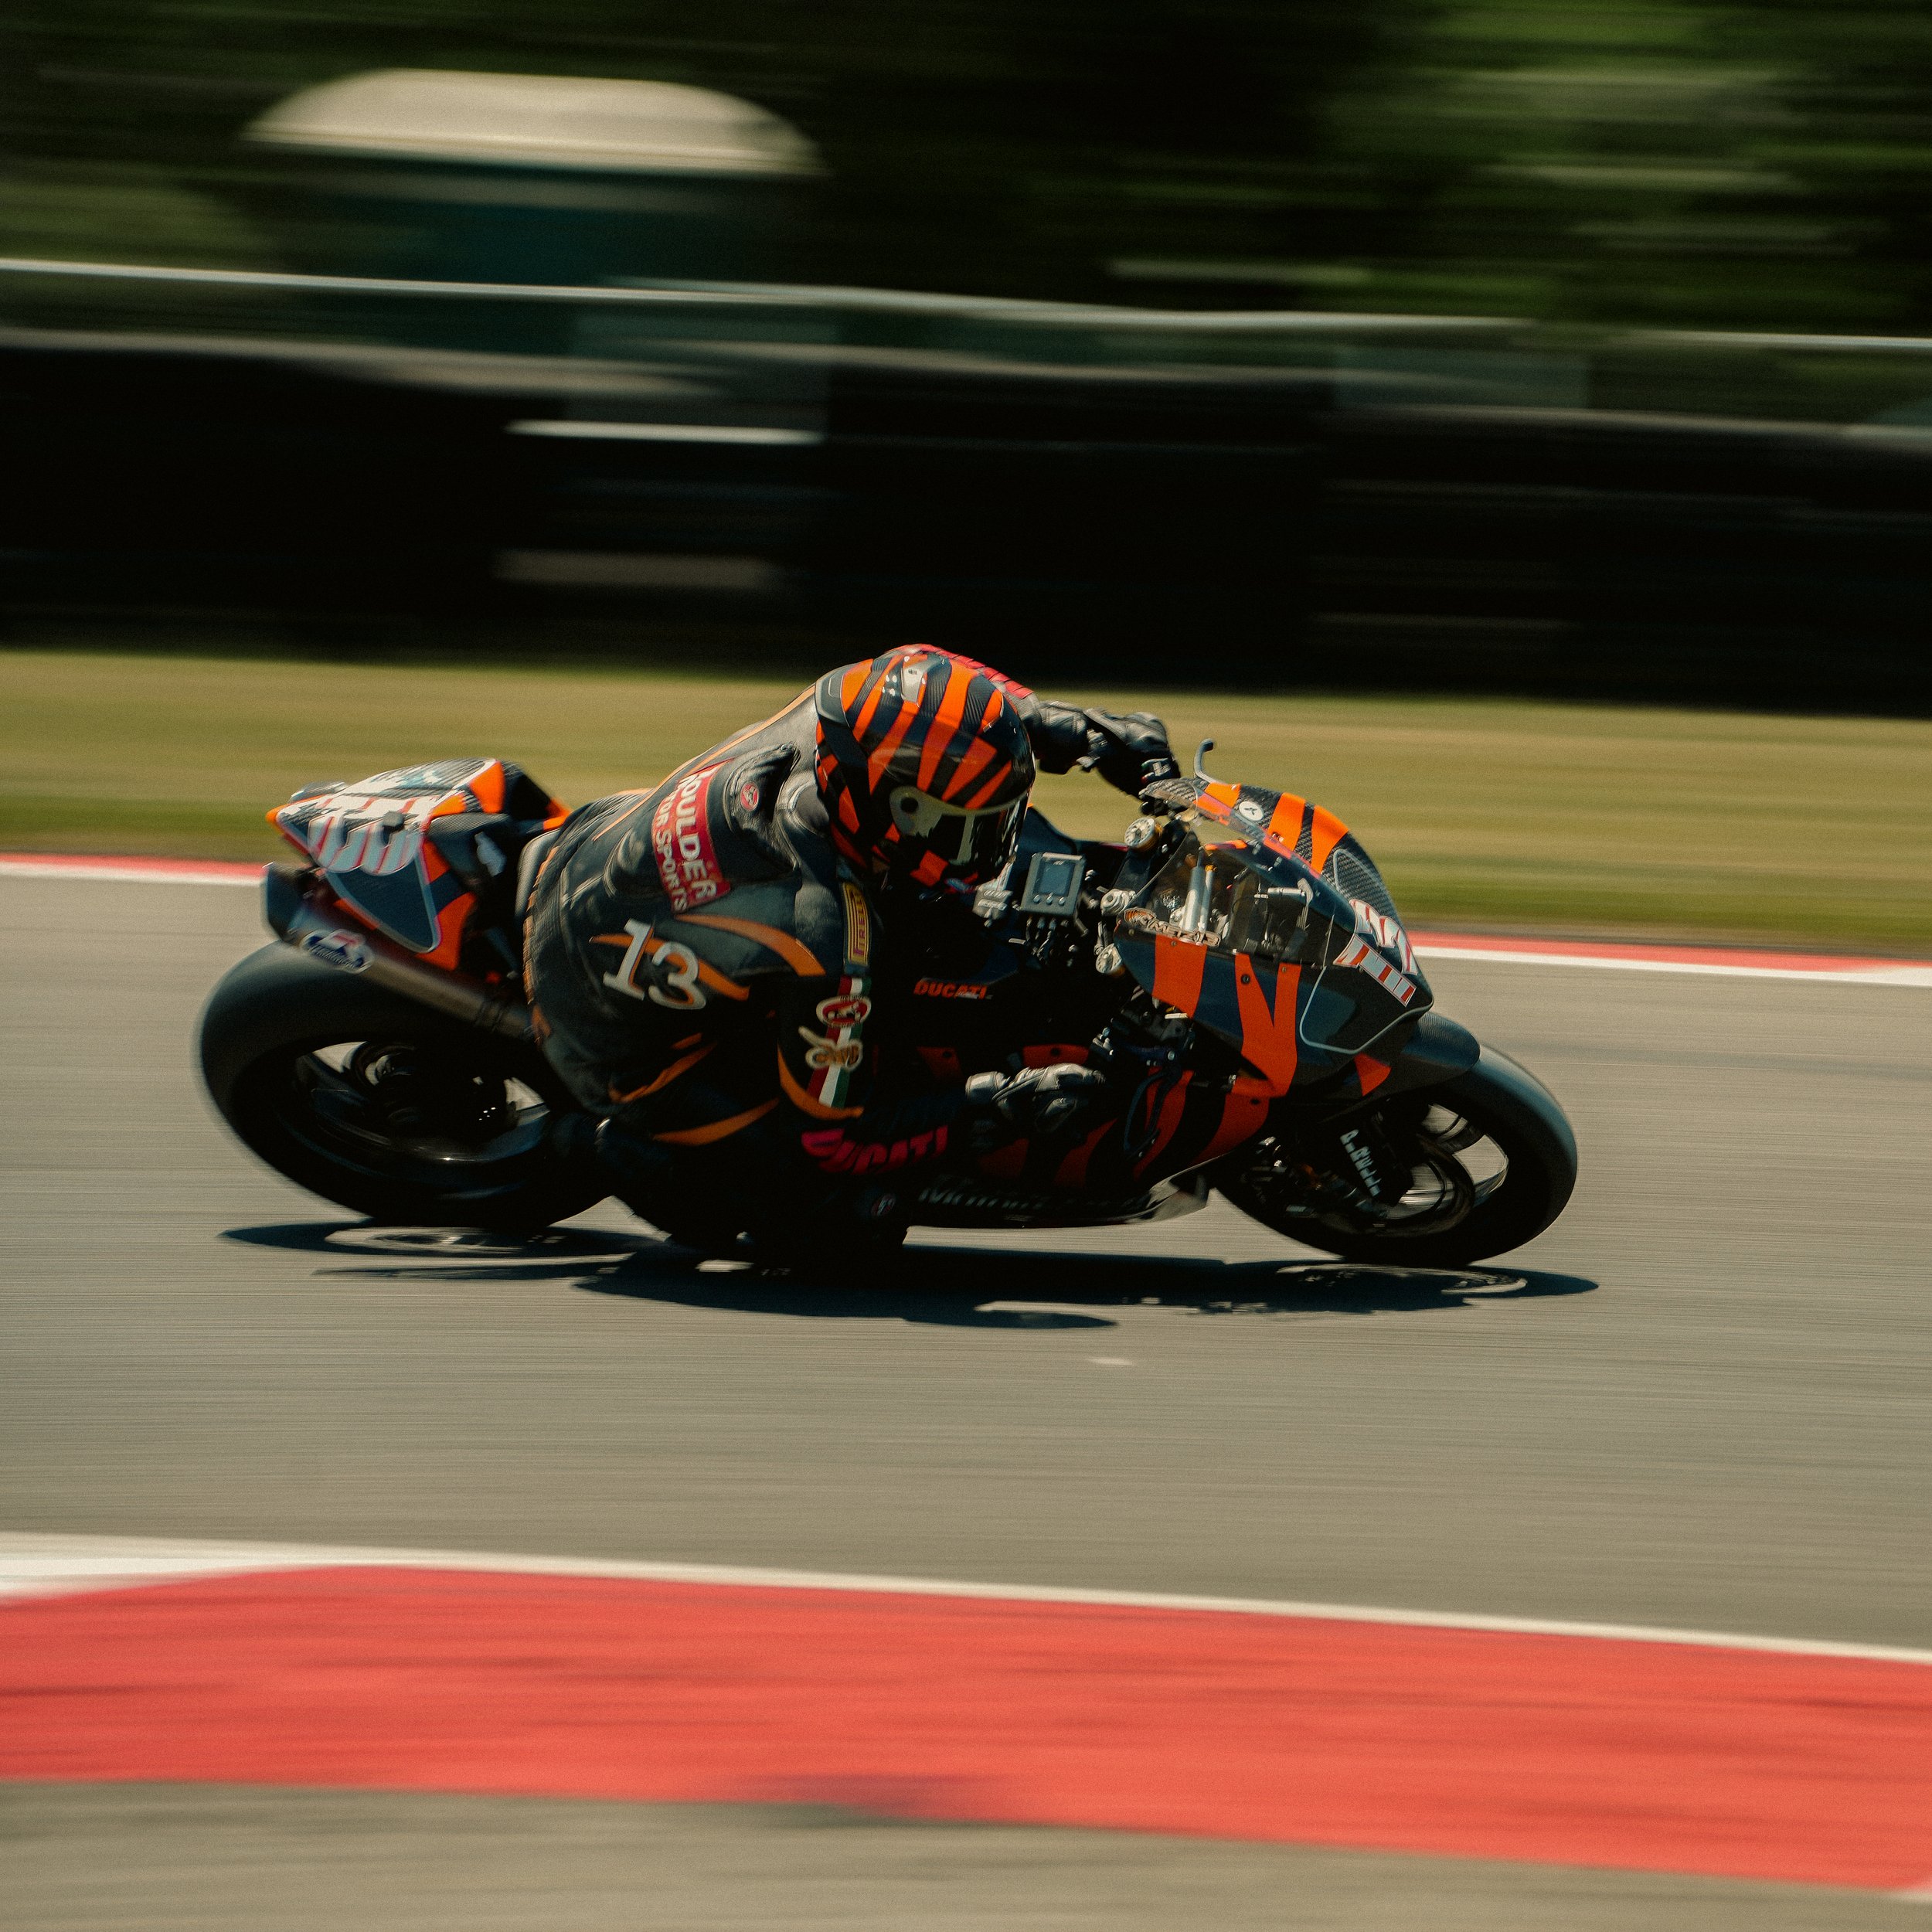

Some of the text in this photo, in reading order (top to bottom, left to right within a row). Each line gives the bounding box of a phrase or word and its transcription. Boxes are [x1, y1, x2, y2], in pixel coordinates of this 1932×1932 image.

[604, 918, 706, 1010] 13
[913, 979, 988, 1000] DUCATI
[801, 1124, 949, 1175] DUCATI
[1339, 1128, 1382, 1197] PIRELLI
